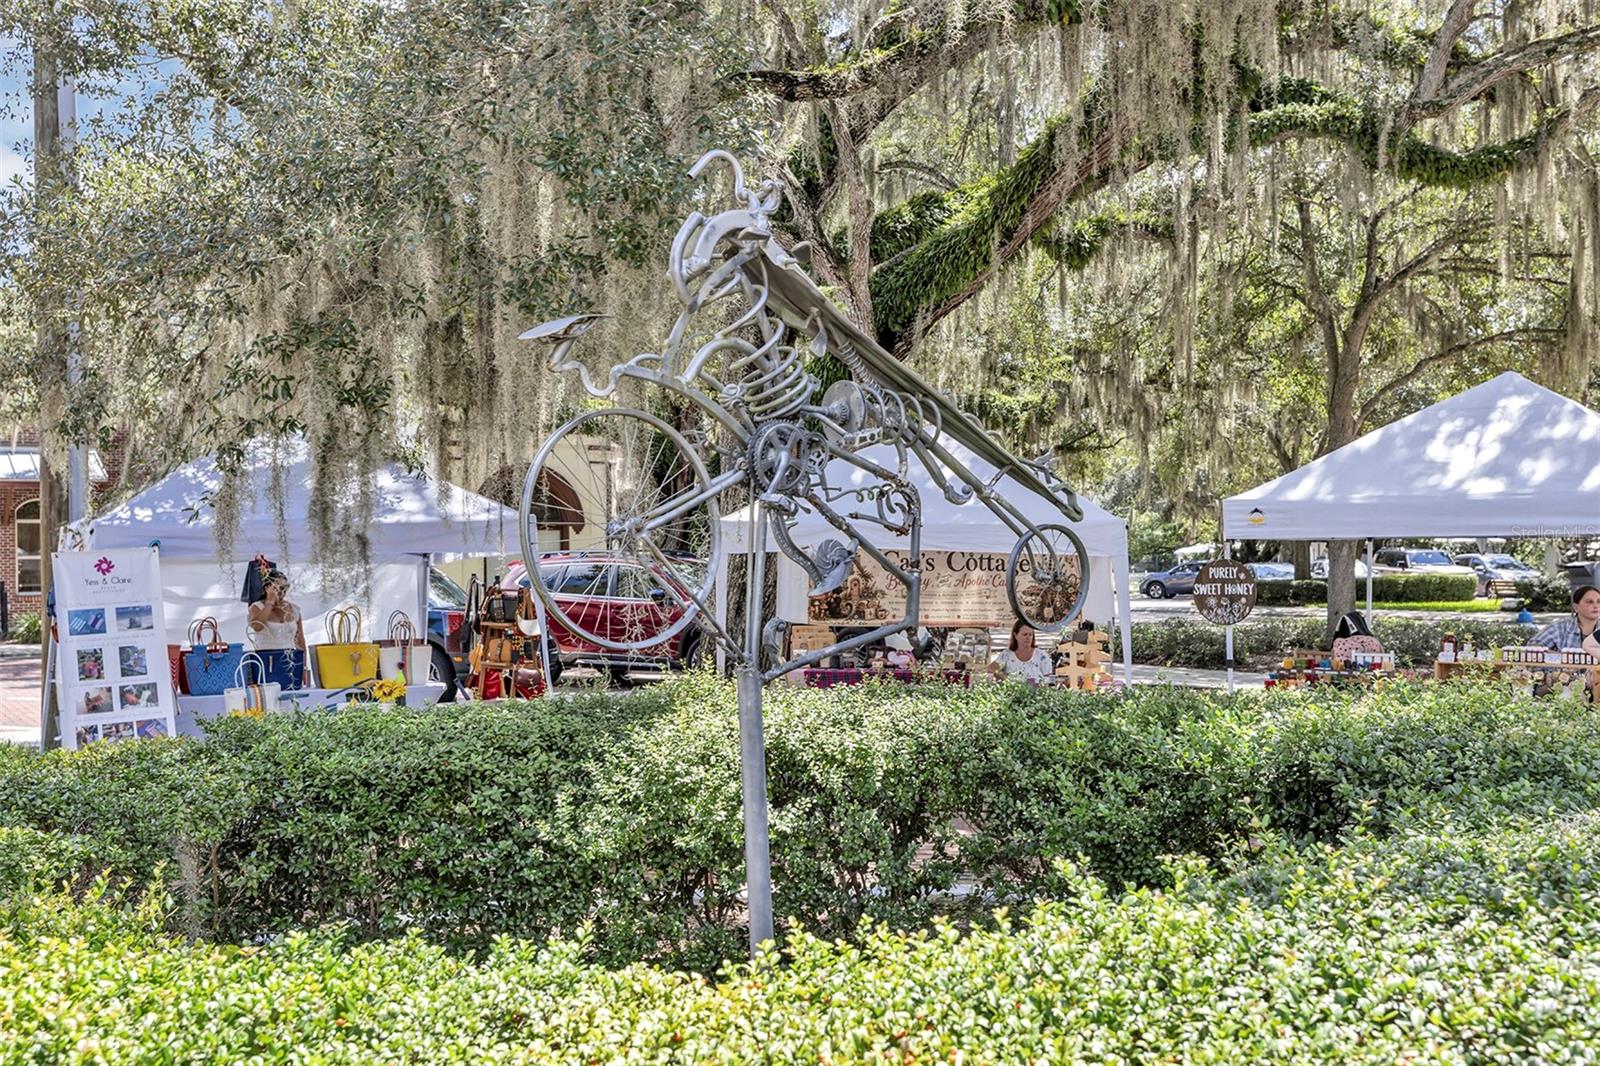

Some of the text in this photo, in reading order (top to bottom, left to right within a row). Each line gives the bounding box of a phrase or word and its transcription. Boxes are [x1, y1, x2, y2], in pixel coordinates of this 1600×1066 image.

[1209, 566, 1238, 579] PURELY
[110, 576, 132, 585] Claire
[1193, 583, 1254, 595] SWEET HONEY
